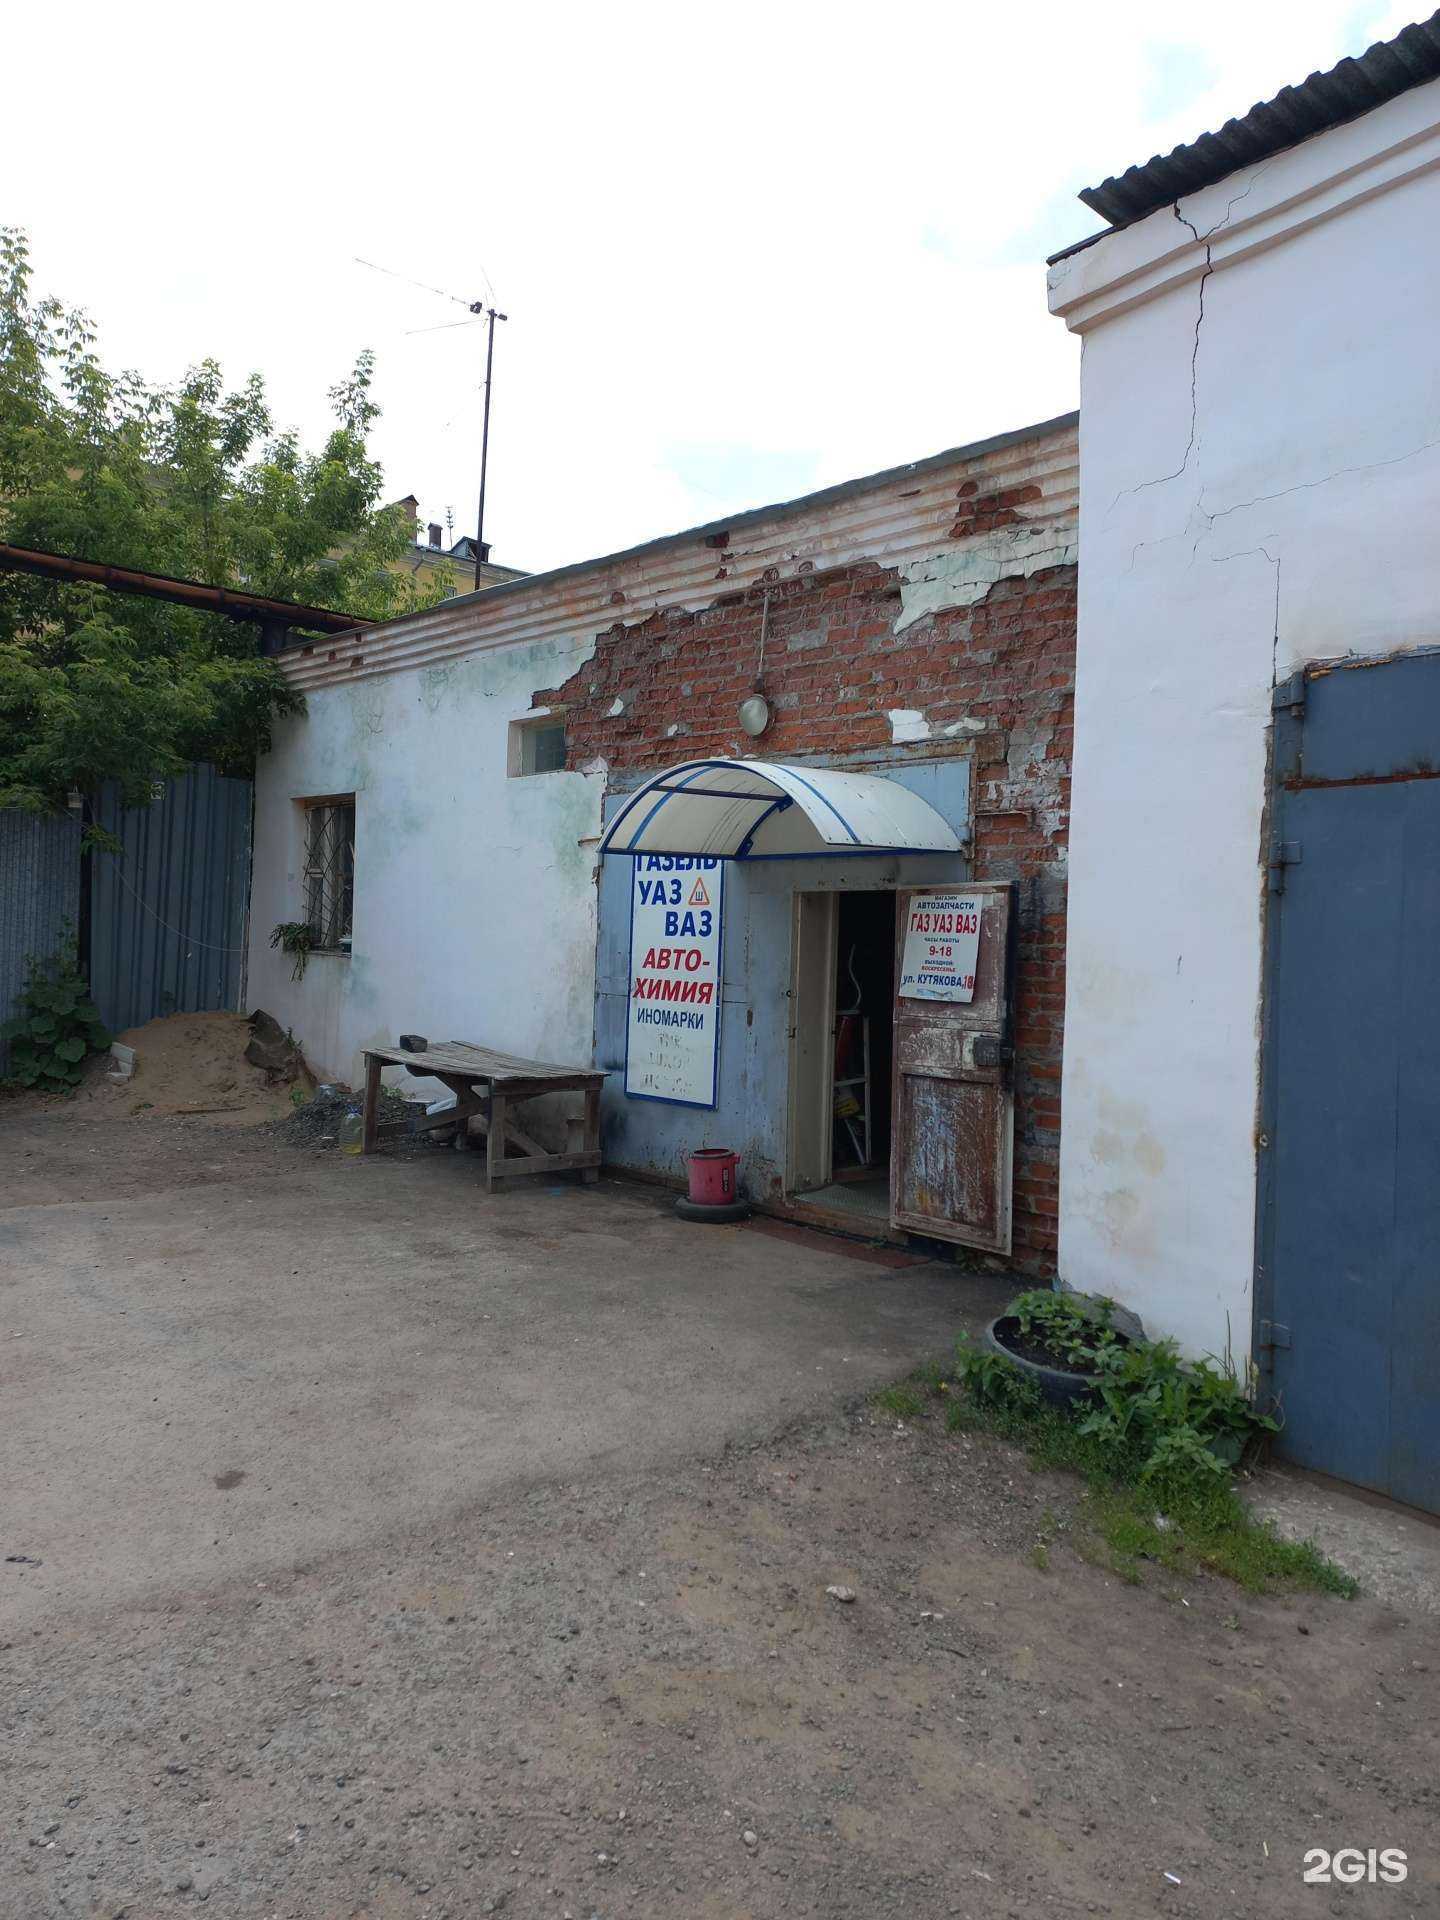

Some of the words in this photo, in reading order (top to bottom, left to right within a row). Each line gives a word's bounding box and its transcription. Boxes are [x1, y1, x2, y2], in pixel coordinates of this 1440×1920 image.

[638, 879, 682, 905] УАЗ
[917, 902, 975, 910] АВТОЗАПЧАСТИ
[664, 910, 712, 937] ВАЗ
[910, 913, 931, 933] ГАЗ
[932, 913, 953, 934] УАЗ
[956, 914, 978, 935] ВАЗ
[642, 947, 711, 972] АВТО-
[929, 945, 952, 957] 9-18
[632, 977, 714, 1005] ХИМИЯ
[903, 975, 915, 985] ул.
[637, 1007, 704, 1030] ИНОМАРКИ
